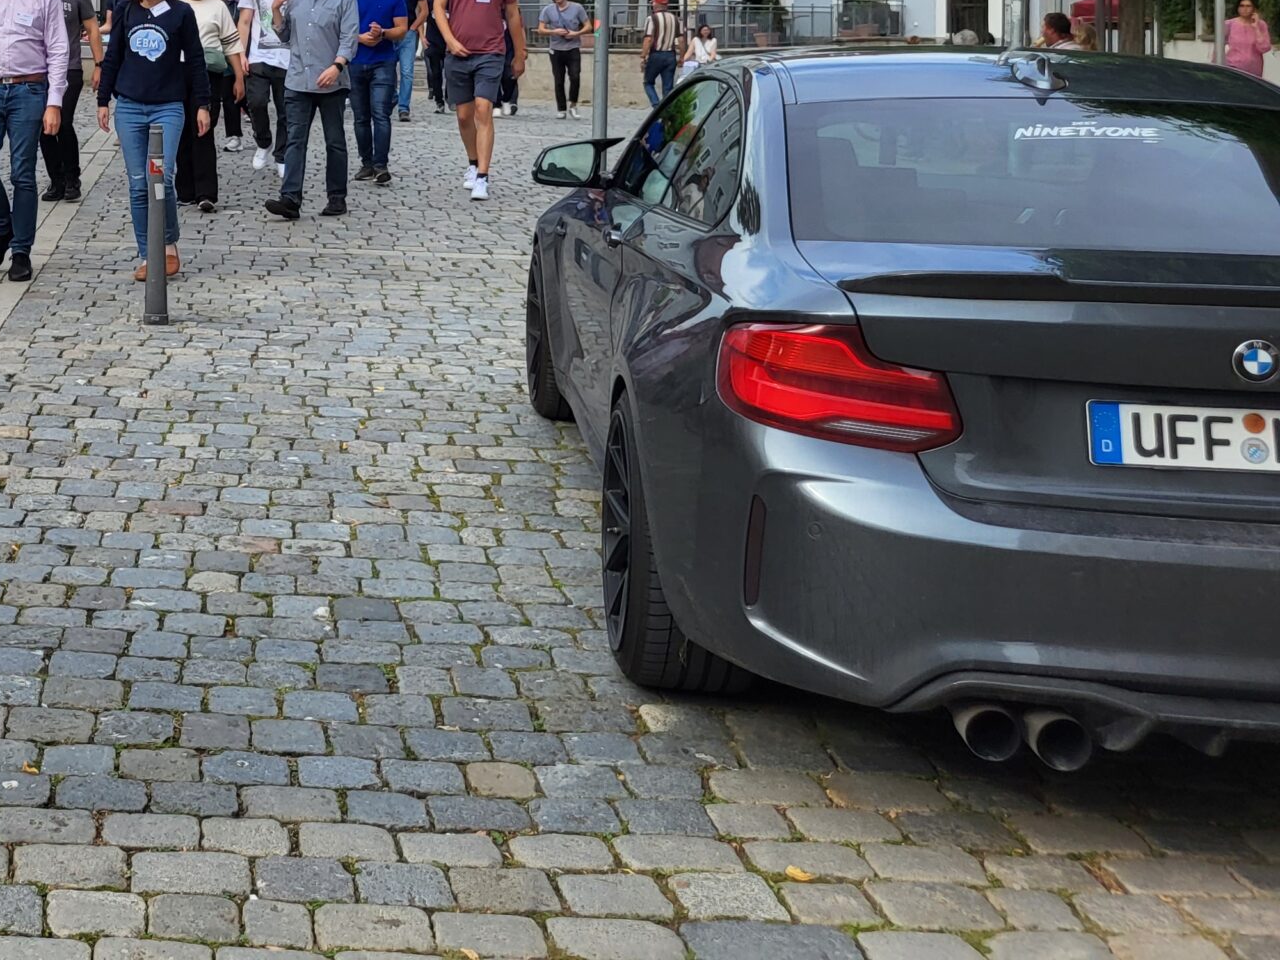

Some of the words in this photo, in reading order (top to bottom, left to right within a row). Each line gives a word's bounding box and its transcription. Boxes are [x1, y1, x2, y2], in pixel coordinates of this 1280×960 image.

[136, 37, 159, 49] EBM
[1101, 439, 1113, 453] D
[1131, 412, 1233, 461] UFF
